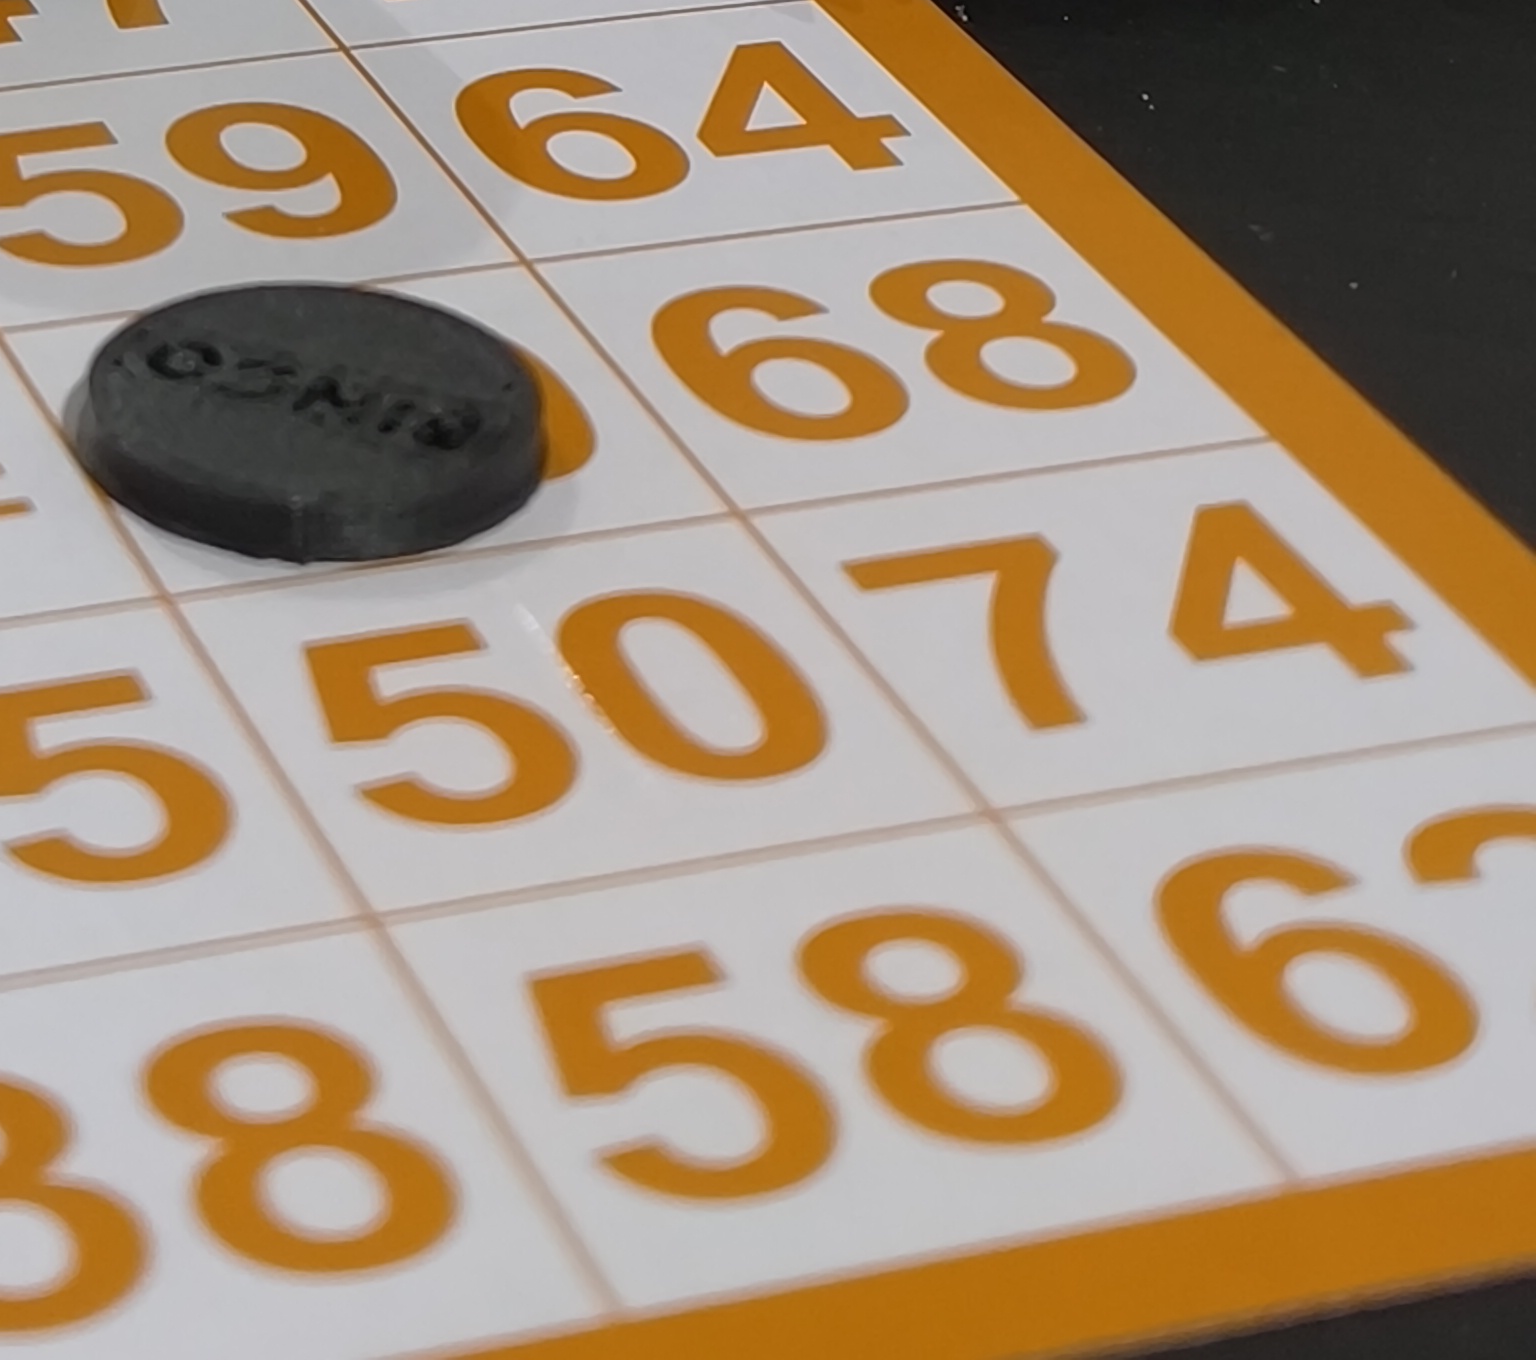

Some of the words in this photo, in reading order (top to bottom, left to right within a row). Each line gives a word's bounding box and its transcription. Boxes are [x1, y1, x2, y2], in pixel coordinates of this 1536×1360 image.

[454, 40, 912, 201] 64
[650, 258, 1137, 443] 68
[302, 584, 830, 830] 50
[838, 498, 1418, 734] 74
[524, 902, 1126, 1205] 58
